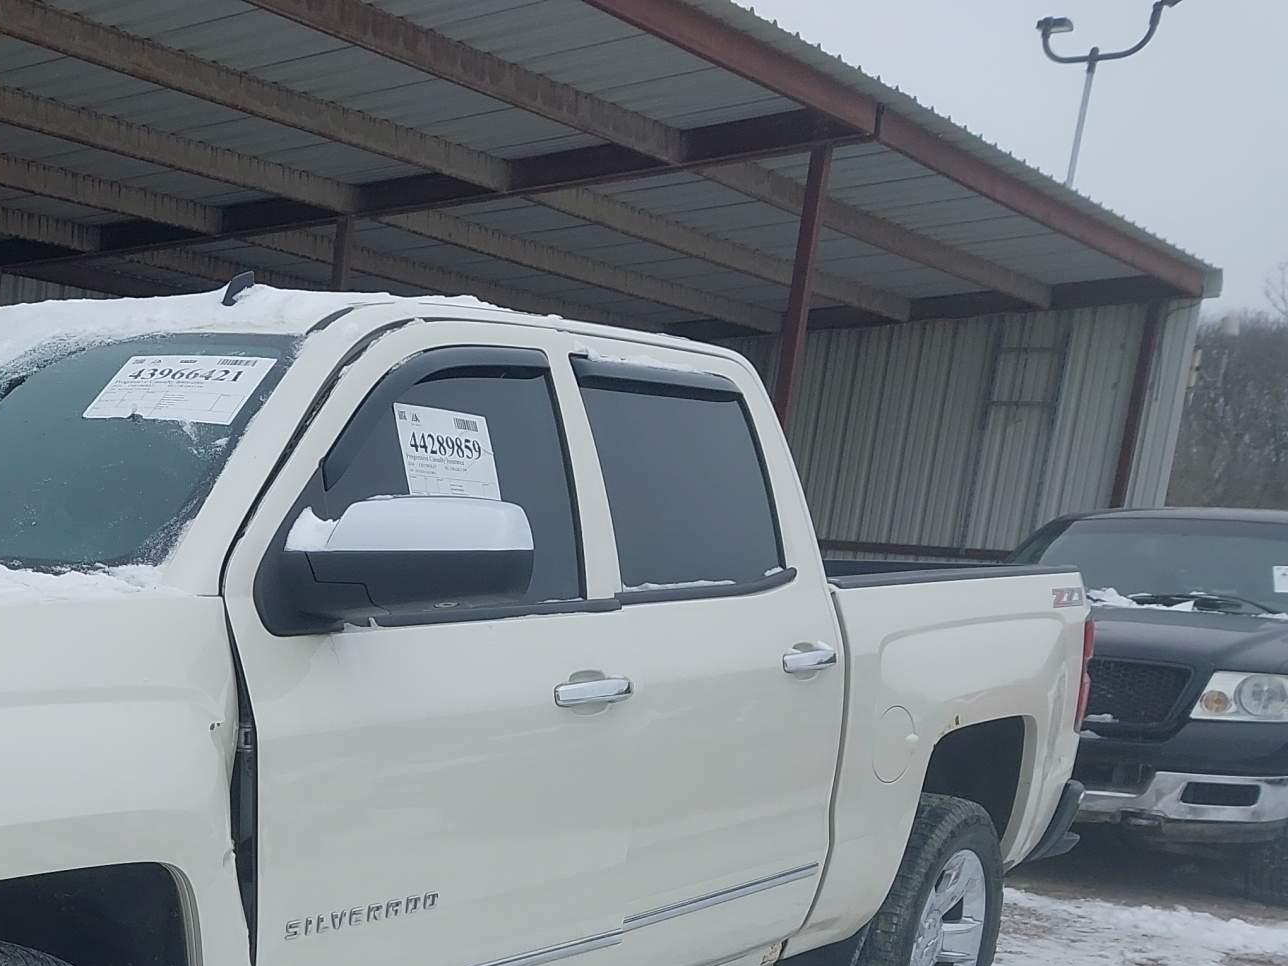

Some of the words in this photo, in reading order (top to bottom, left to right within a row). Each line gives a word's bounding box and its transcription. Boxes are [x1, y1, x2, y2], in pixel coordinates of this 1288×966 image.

[128, 367, 244, 383] 43966421
[409, 431, 482, 460] 44289859
[284, 890, 440, 940] SILVERADO
